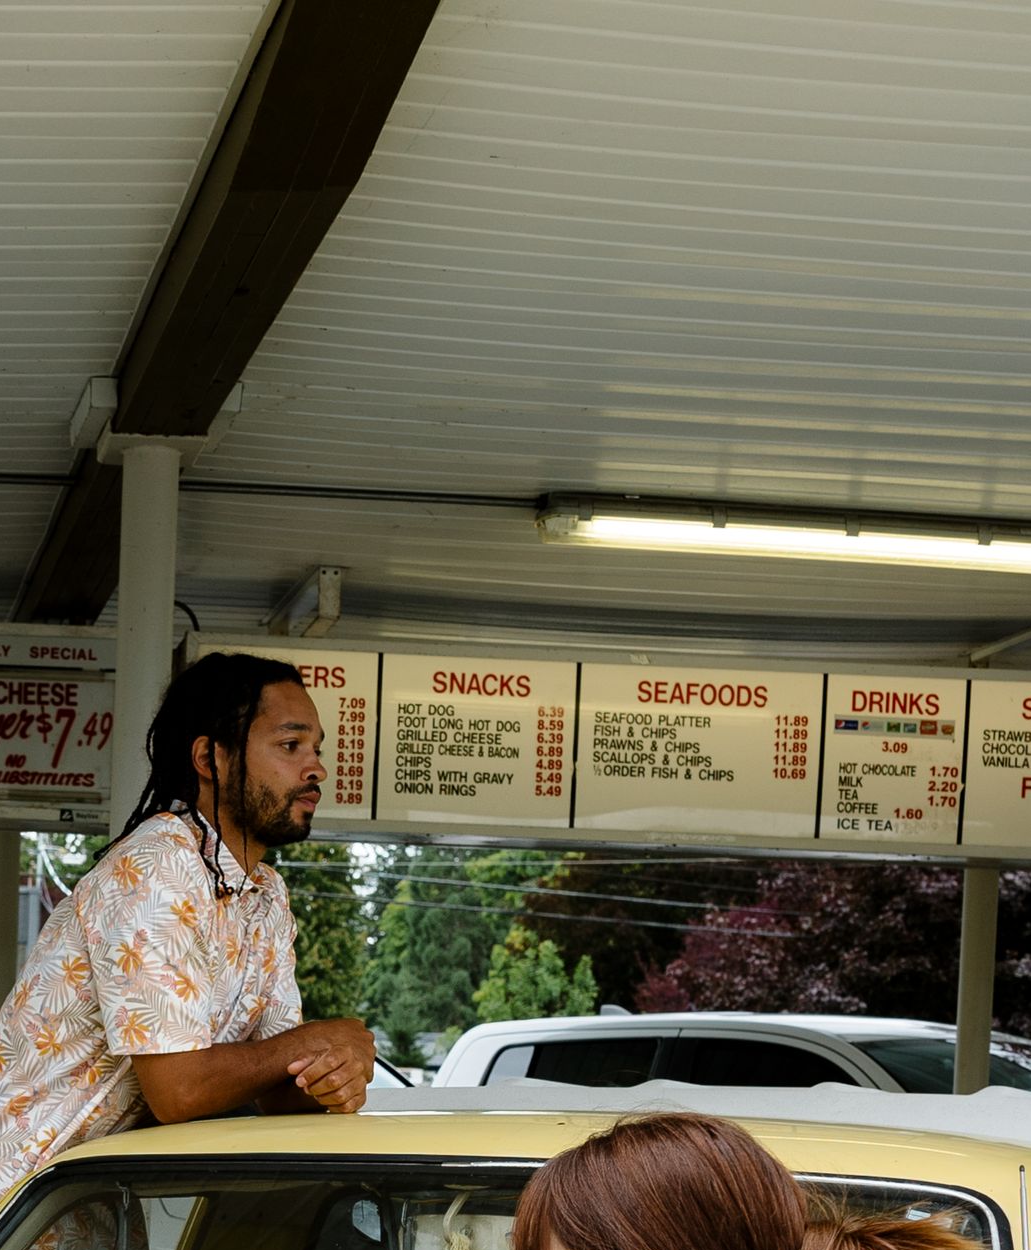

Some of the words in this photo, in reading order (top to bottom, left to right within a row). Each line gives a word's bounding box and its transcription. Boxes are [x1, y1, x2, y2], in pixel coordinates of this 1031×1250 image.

[29, 646, 97, 661] SPECIAL
[432, 671, 531, 697] SNACKS
[637, 681, 768, 708] SEAFOODS
[339, 697, 366, 709] 7.09
[398, 703, 422, 715] HOT
[428, 704, 455, 716] DOG
[538, 706, 564, 718] 6.39
[852, 690, 939, 716] DRINKS
[338, 711, 365, 723] 7.99
[397, 716, 427, 728] FOOT
[432, 718, 463, 730] LONG
[469, 719, 491, 731] HOT
[496, 720, 521, 733] DOG
[537, 719, 564, 731] 8.59
[595, 711, 652, 726] SEAFOOD
[658, 714, 711, 728] PLATTER
[775, 715, 808, 727] 11.89
[338, 724, 365, 736] 8.19
[397, 729, 448, 743] GRILLED
[453, 732, 502, 745] CHEESE
[537, 732, 563, 744] 6.39
[594, 725, 620, 737] FISH
[627, 726, 634, 737] &
[641, 727, 677, 739] CHIPS
[774, 728, 808, 740] 11.89
[337, 738, 364, 750] 8.19
[396, 742, 434, 755] GRILLED
[438, 744, 474, 757] CHEESE
[478, 746, 484, 758] &
[488, 746, 520, 759] BACON
[536, 745, 563, 757] 6.89
[593, 738, 643, 751] PRAWNS
[650, 740, 658, 751] &
[665, 741, 700, 754] CHIPS
[774, 741, 807, 753] 11.89
[882, 741, 908, 754] 3.09
[5, 754, 26, 768] NO
[337, 751, 364, 763] 8.19
[395, 755, 432, 768] CHIPS
[536, 759, 562, 770] 4.89
[593, 751, 655, 765] SCALLOPS
[662, 754, 670, 765] &
[677, 755, 712, 767] CHIPS
[773, 755, 807, 766] 11.89
[982, 755, 1030, 768] VANILLA
[336, 765, 364, 777] 8.69
[395, 768, 431, 781] CHIPS
[437, 770, 468, 783] WITH
[473, 772, 514, 785] GRAVY
[535, 772, 562, 783] 5.49
[651, 767, 678, 779] FISH
[684, 768, 692, 780] &
[698, 769, 734, 782] CHIPS
[773, 768, 806, 779] 10.69
[839, 762, 857, 774] HOT
[862, 763, 916, 777] CHOCOLATE
[929, 766, 958, 778] 1.70
[336, 779, 363, 791] 8.19
[394, 781, 433, 795] ONION
[439, 783, 476, 797] RINGS
[535, 785, 562, 797] 5.49
[838, 776, 863, 788] MILK
[928, 781, 958, 793] 2.20
[335, 792, 363, 804] 9.89
[838, 789, 858, 801] TEA
[927, 796, 957, 807] 1.70
[837, 802, 878, 815] COFFEE
[894, 808, 923, 820] 1.60
[837, 818, 860, 830] ICE
[867, 819, 893, 832] TEA
